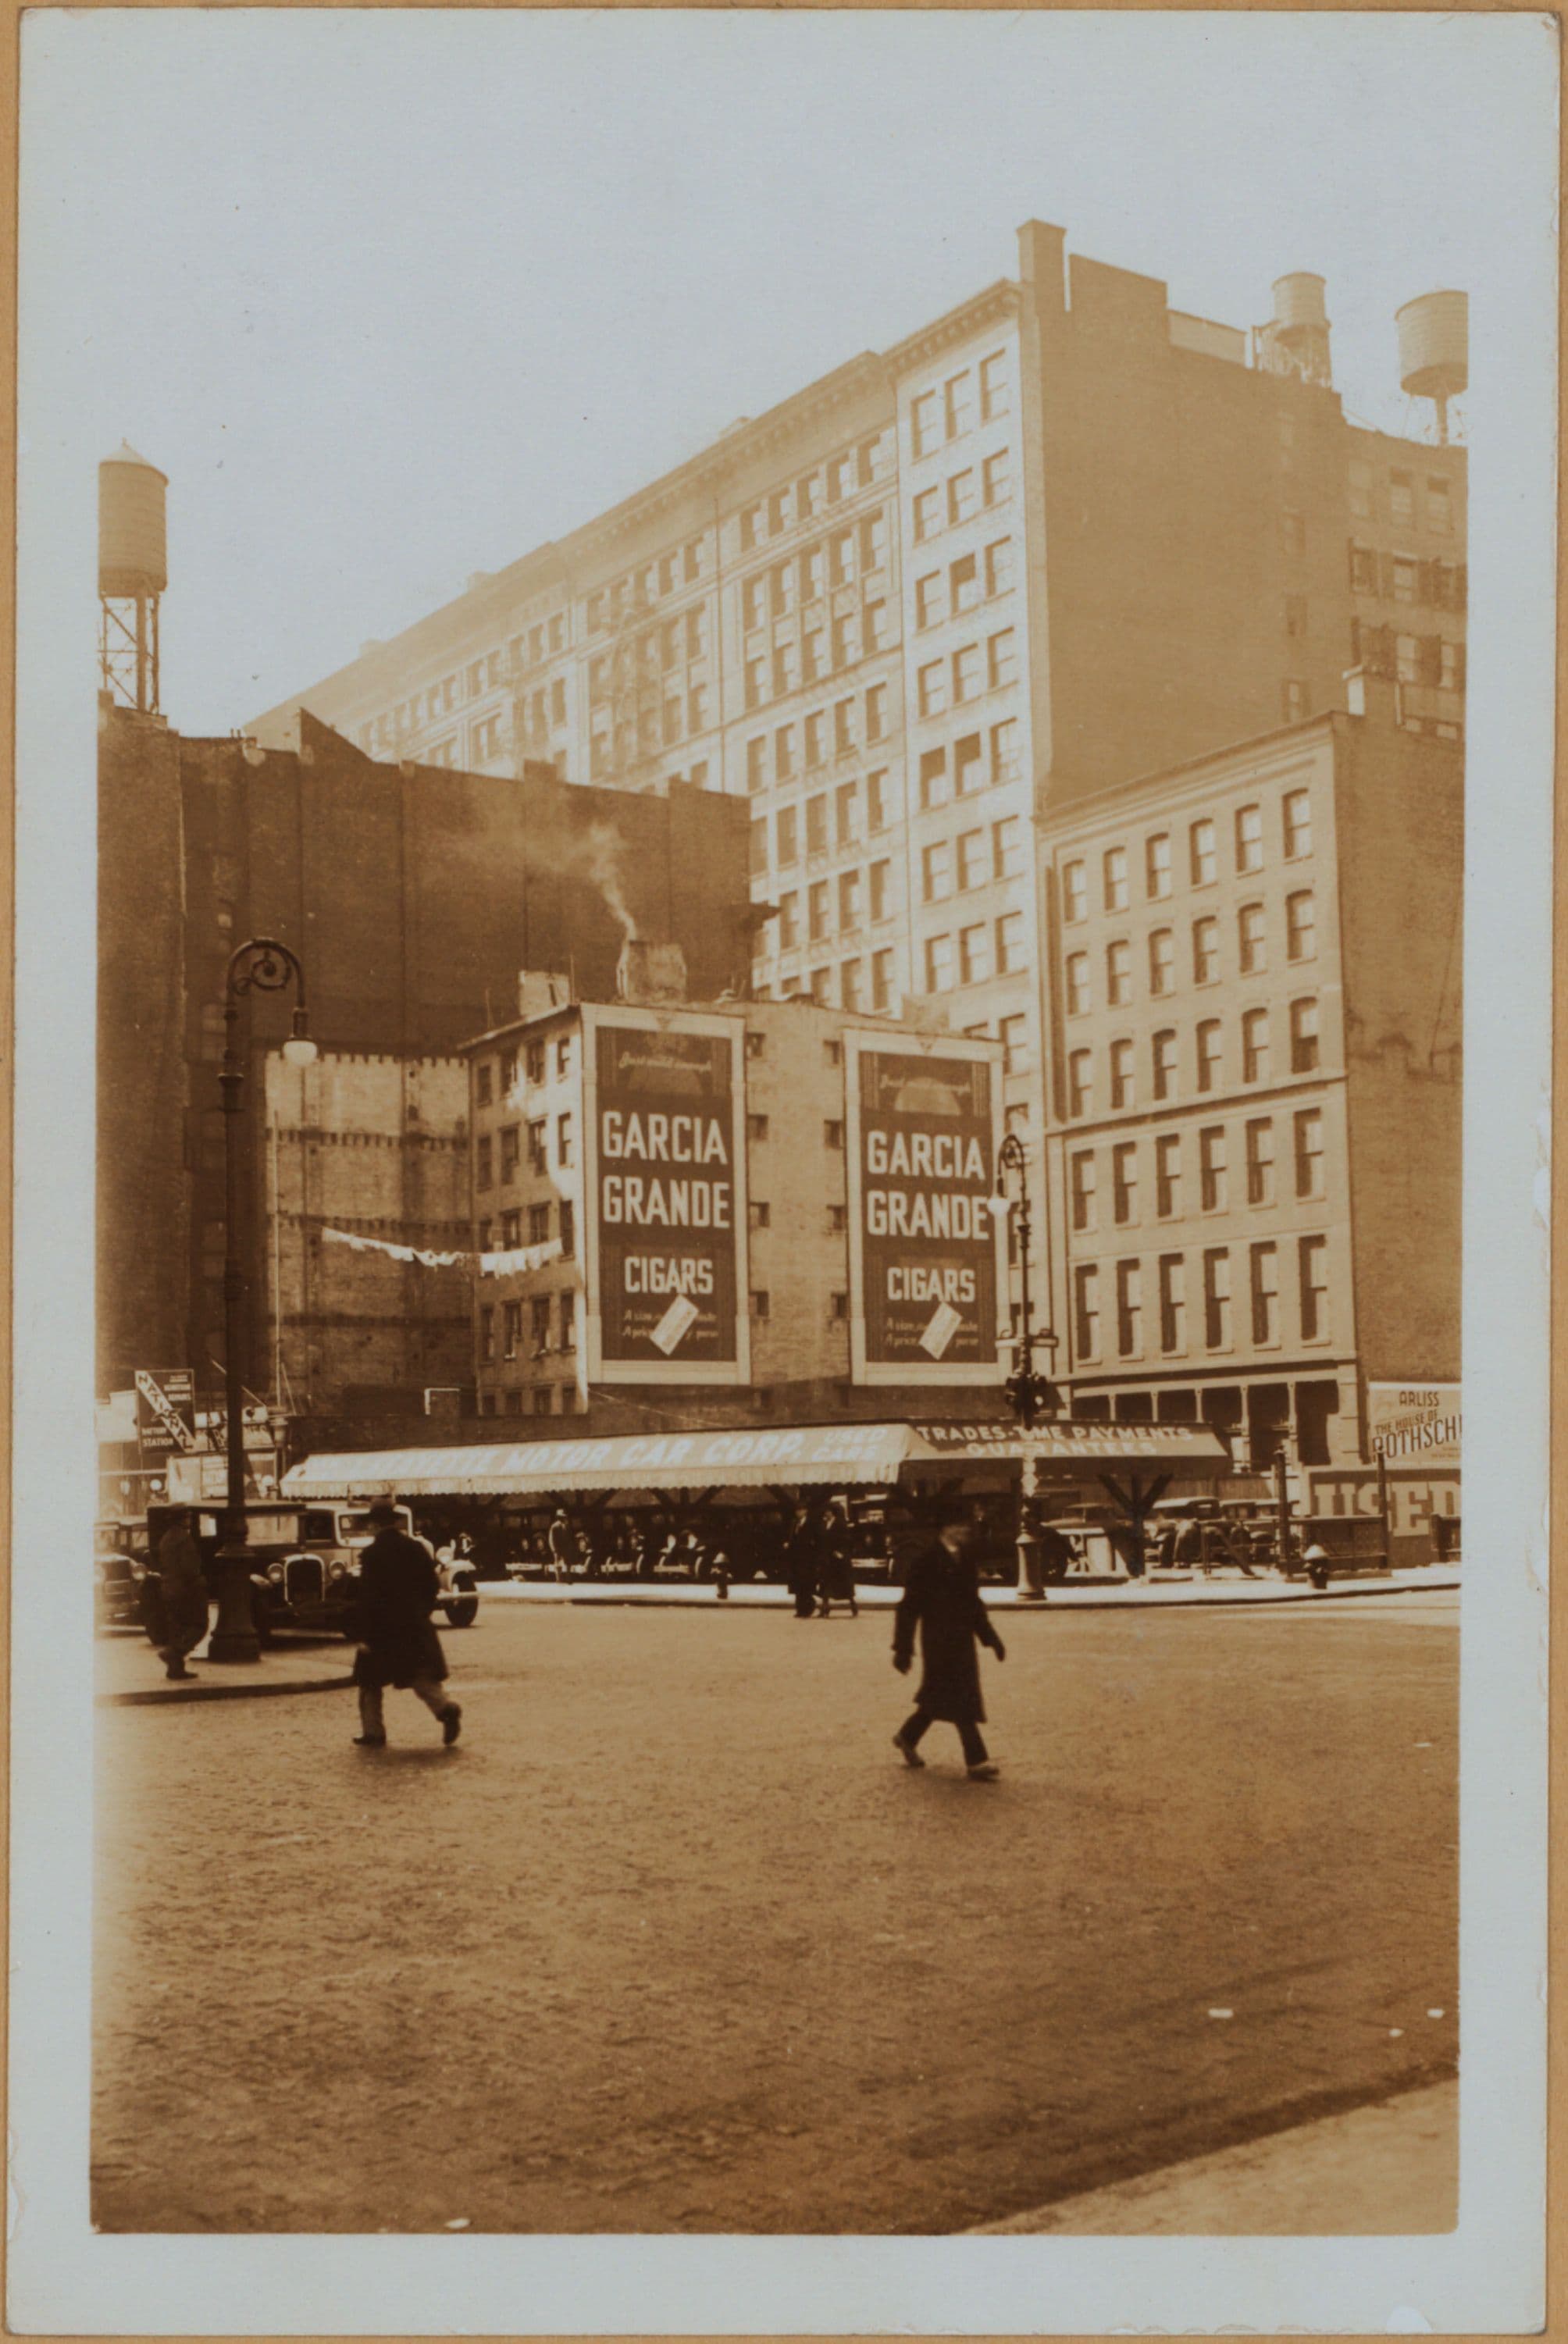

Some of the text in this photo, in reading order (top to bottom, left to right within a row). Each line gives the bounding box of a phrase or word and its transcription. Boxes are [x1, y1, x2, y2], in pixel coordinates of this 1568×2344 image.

[602, 1110, 728, 1165] GARCIA
[867, 1130, 985, 1181] GARCIA
[602, 1175, 730, 1229] GRANDE
[867, 1190, 990, 1240] GRANDE
[625, 1256, 714, 1295] CIGARS
[887, 1266, 976, 1302] CIGARS
[1399, 1390, 1439, 1406] ARLISS
[825, 1427, 888, 1444] USED
[1071, 1426, 1194, 1441] PAYMENTS
[1374, 1421, 1392, 1434] THE
[500, 1443, 612, 1475] MOTOR
[618, 1438, 693, 1466] CAR
